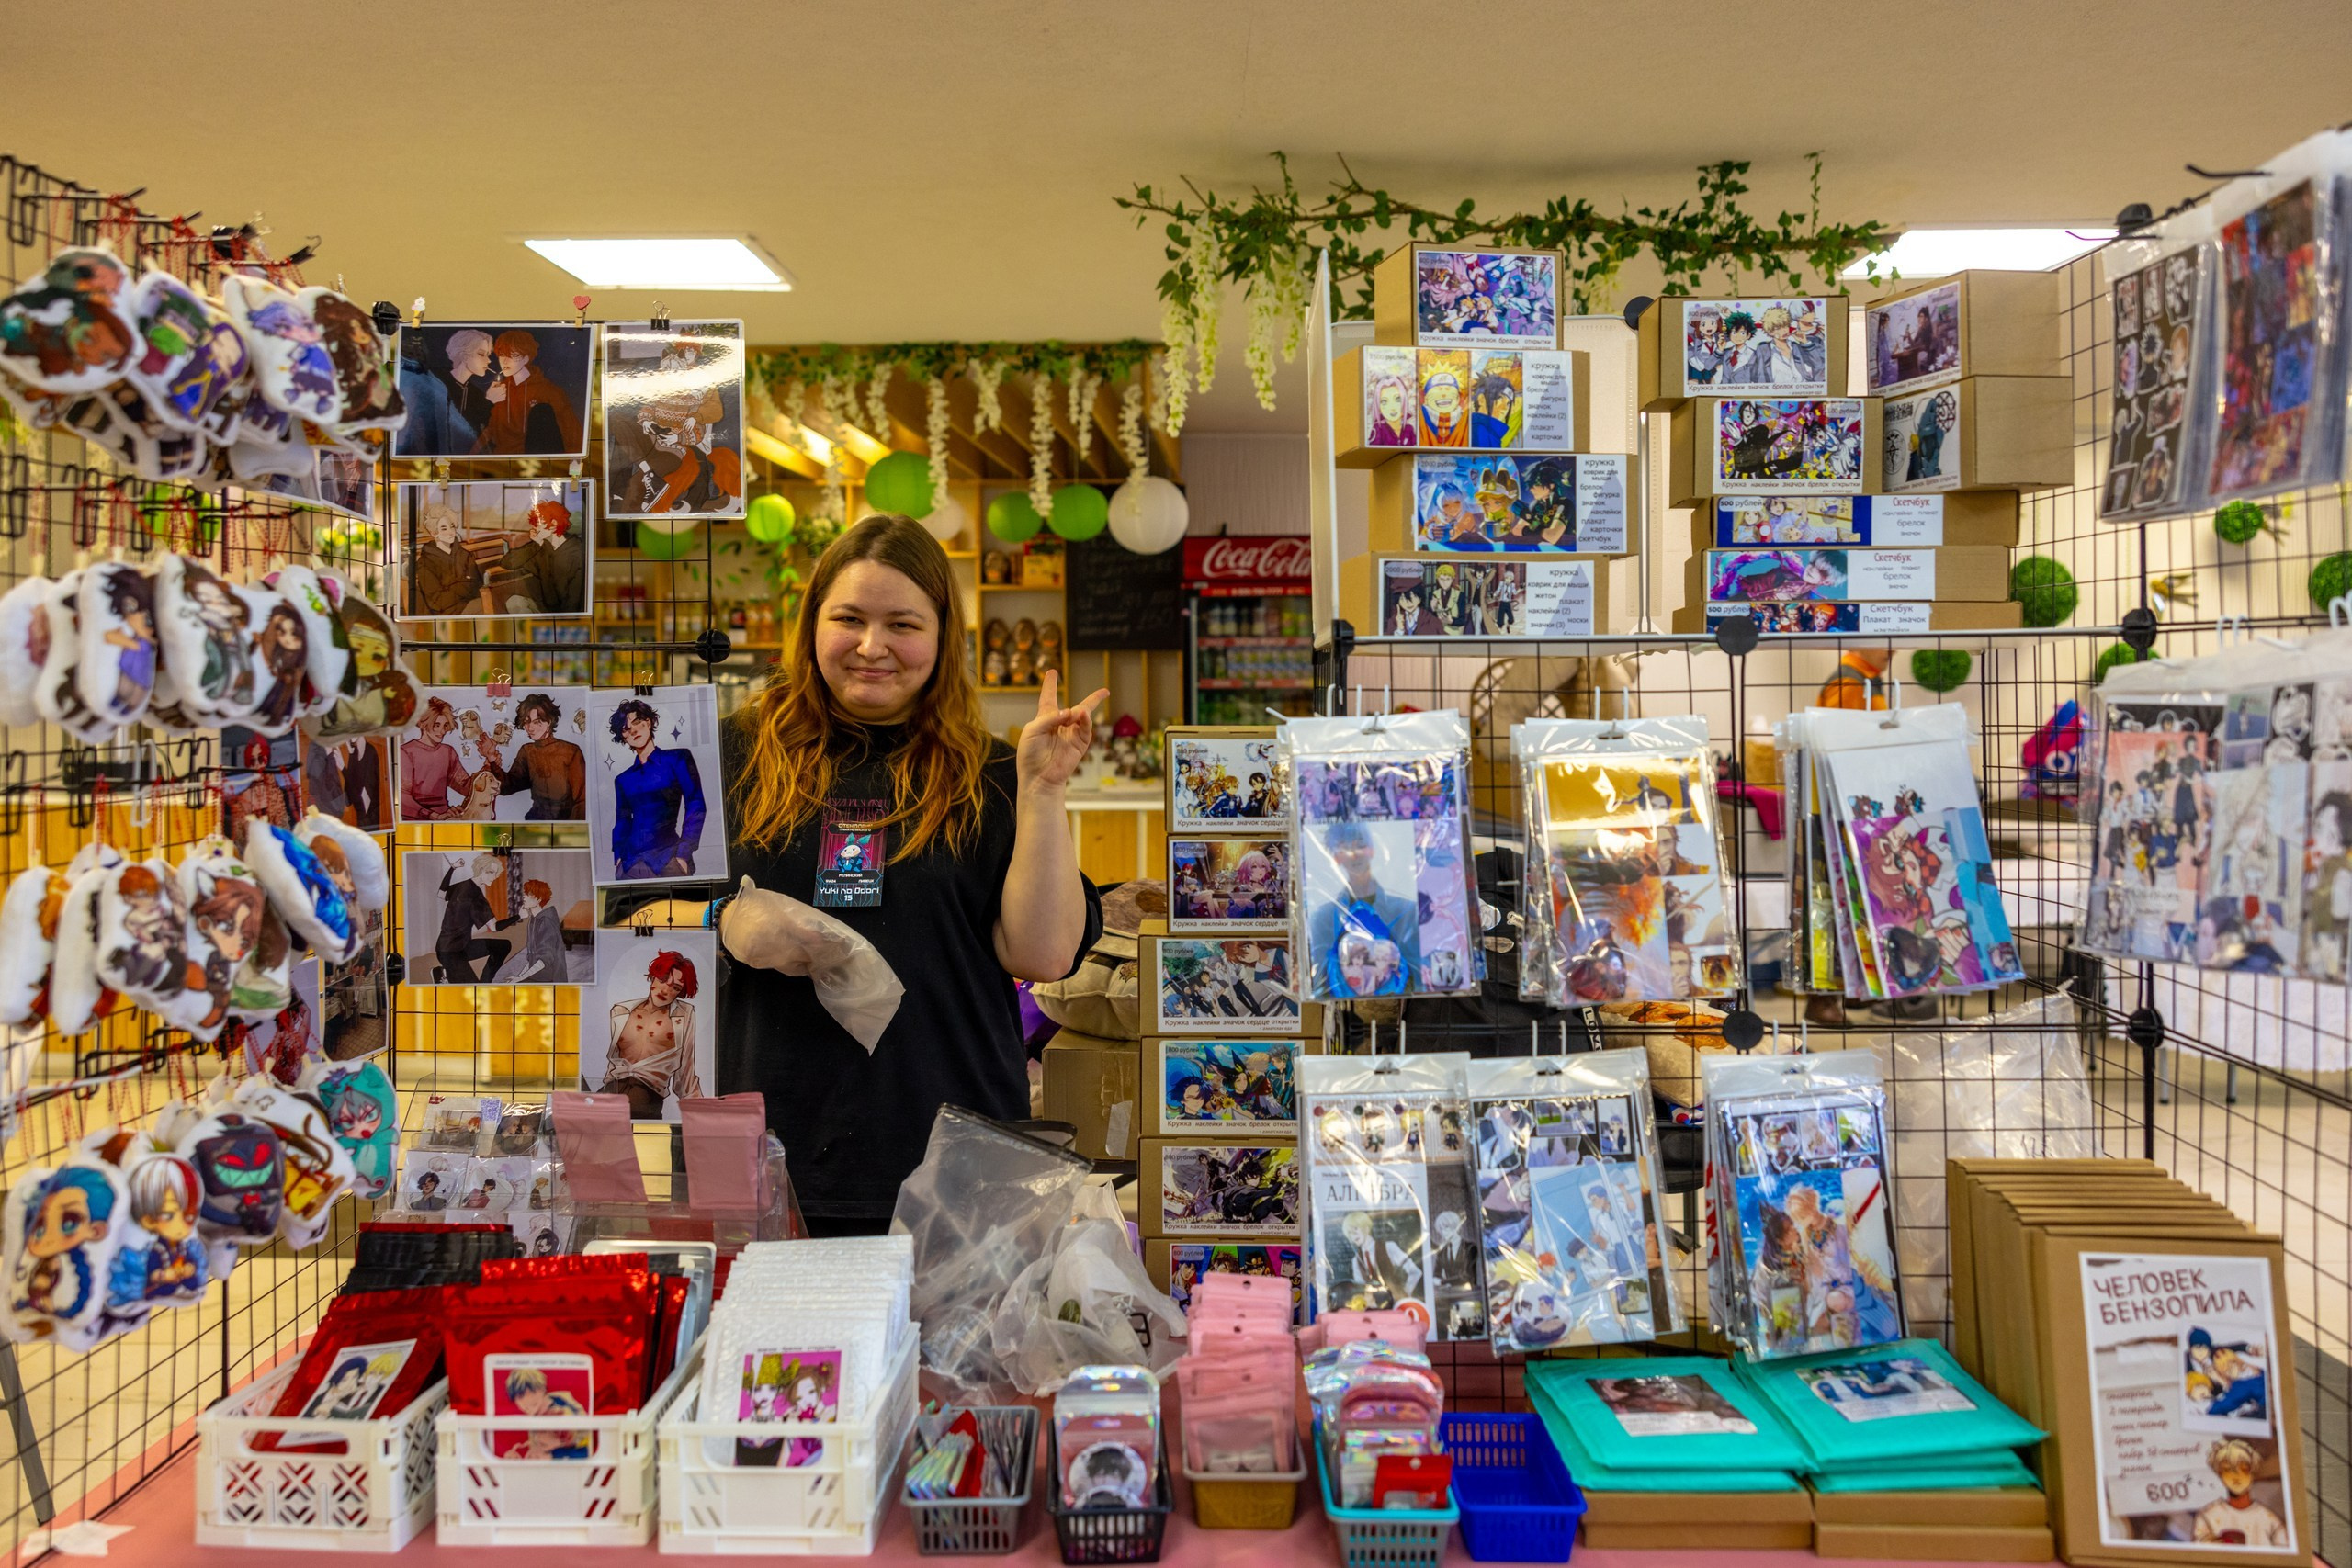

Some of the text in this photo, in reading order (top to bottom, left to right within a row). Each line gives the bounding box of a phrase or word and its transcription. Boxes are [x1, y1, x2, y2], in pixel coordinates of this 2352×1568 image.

[1531, 363, 1561, 371] кружка
[1585, 459, 1615, 468] кружка
[1735, 499, 1763, 508] рублей
[1893, 497, 1930, 508] Скетчбук
[1896, 519, 1926, 527] брелок
[1874, 552, 1912, 563] Скетчбук
[1549, 570, 1579, 578] кружка
[1883, 572, 1912, 581] брелок
[1561, 607, 1571, 615] (2)
[1723, 604, 1750, 615] рублей
[1870, 604, 1914, 615] Скетчбук
[1862, 615, 1891, 624] Плакат
[1555, 621, 1566, 629] (3)
[1177, 819, 1202, 828] Кружка
[854, 886, 879, 895] Odori
[1255, 920, 1279, 929] сердце
[1164, 1019, 1189, 1027] Кружка
[1179, 1045, 1200, 1054] рублей
[1167, 1121, 1192, 1129] Кружка
[1249, 1120, 1271, 1128] брелок
[1176, 1154, 1197, 1162] рублей
[2093, 1268, 2208, 1300] ЧЕЛОВЕК
[2099, 1289, 2256, 1325] БЕНЗОПИЛА
[2146, 1481, 2189, 1503] 600
